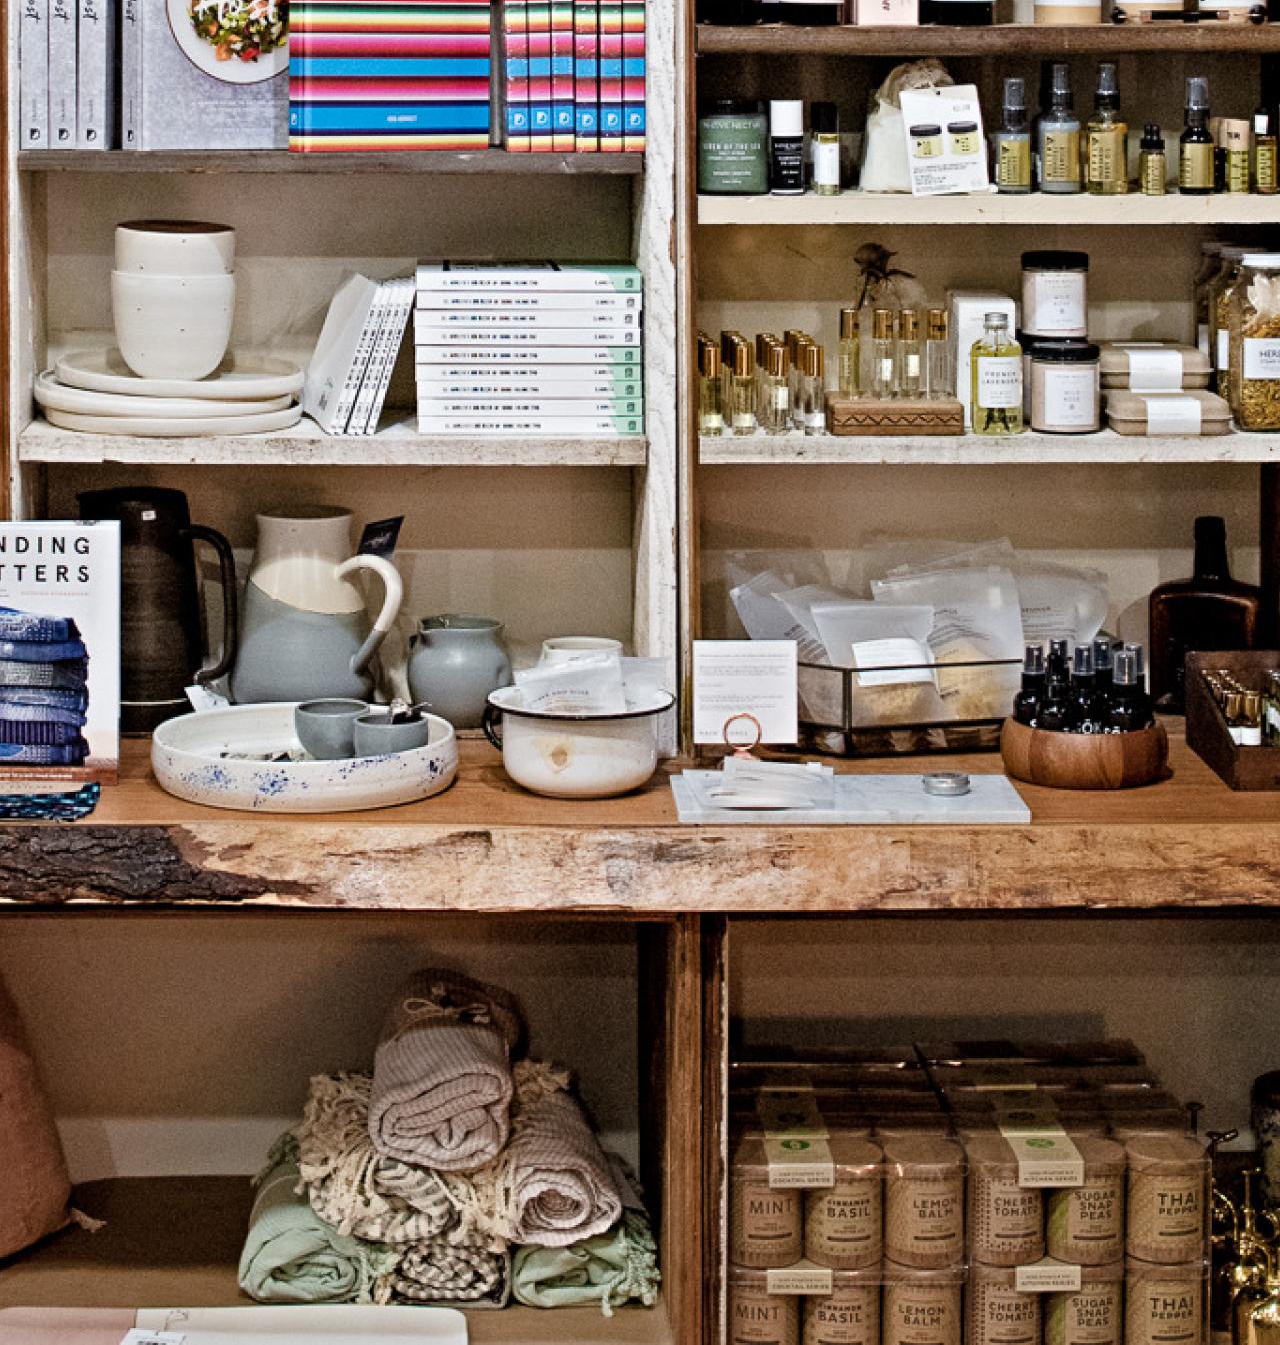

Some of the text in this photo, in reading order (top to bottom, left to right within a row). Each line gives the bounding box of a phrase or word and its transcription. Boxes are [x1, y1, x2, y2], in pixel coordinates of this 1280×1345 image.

[1074, 1190, 1117, 1202] SUGAR
[1157, 1191, 1198, 1206] THAI
[748, 1198, 793, 1215] MINT
[913, 1197, 958, 1209] LEMON
[1080, 1201, 1113, 1211] SNAP
[826, 1206, 871, 1219] BASIL
[918, 1207, 955, 1218] BALM
[994, 1206, 1039, 1217] TOMATO
[1079, 1210, 1113, 1221] PEAS
[1158, 1205, 1199, 1216] PEPPER
[1071, 1297, 1114, 1309] SUGAR
[1150, 1296, 1194, 1311] THAI
[735, 1304, 780, 1320] MINT
[898, 1304, 945, 1316] LEMON
[1076, 1307, 1110, 1318] SNAP
[1151, 1310, 1194, 1320] PEPPER
[817, 1311, 862, 1324] BASIL
[903, 1315, 941, 1326] BALM
[989, 1311, 1035, 1322] TOMATO
[1076, 1317, 1110, 1327] PEAS
